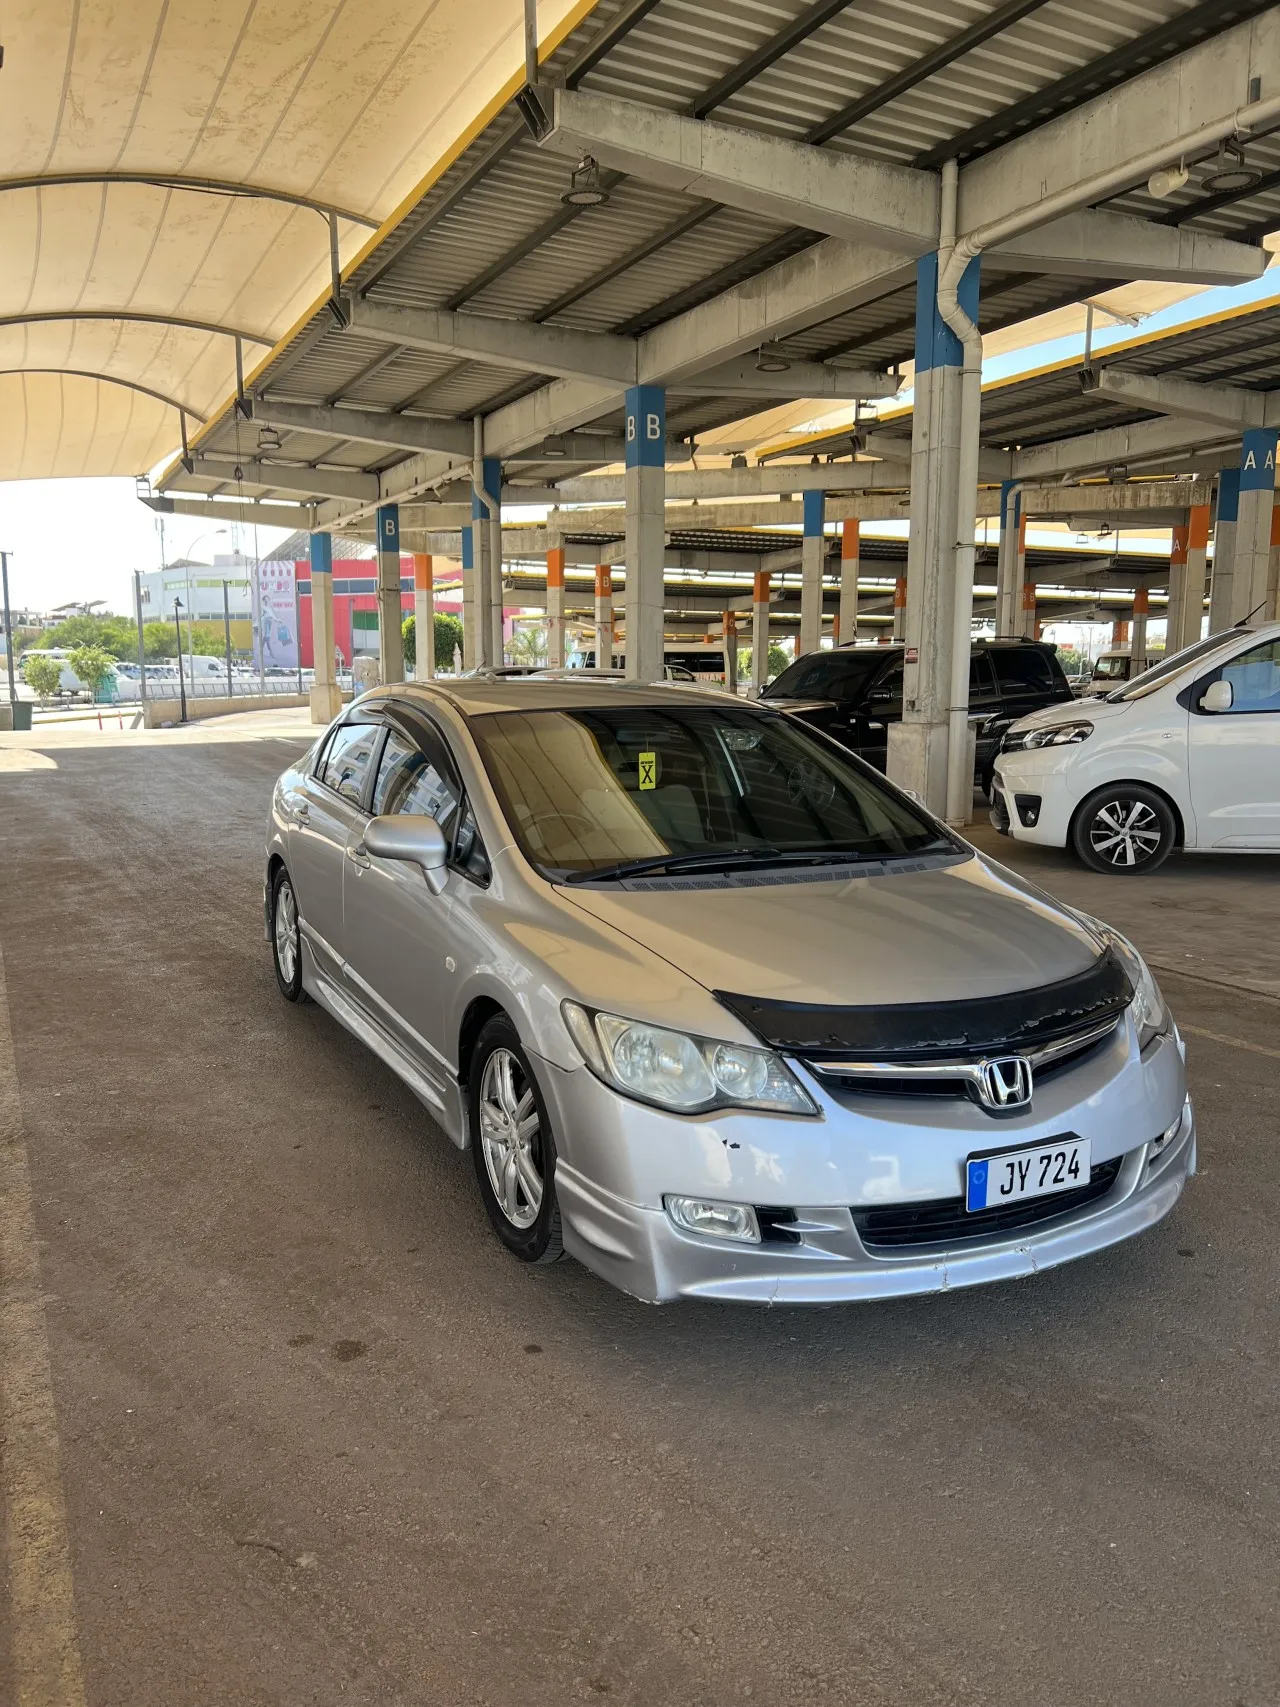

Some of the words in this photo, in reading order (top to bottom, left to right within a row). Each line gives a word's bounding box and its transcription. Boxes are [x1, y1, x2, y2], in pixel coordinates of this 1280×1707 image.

[627, 415, 636, 442] B
[647, 414, 660, 440] B
[1243, 450, 1257, 470] A
[1264, 449, 1274, 470] A
[385, 519, 396, 536] B
[1173, 539, 1181, 551] A
[603, 576, 609, 587] B
[1030, 592, 1035, 602] B
[641, 764, 654, 784] X
[1000, 1158, 1031, 1195] JY
[1038, 1148, 1080, 1188] 724
